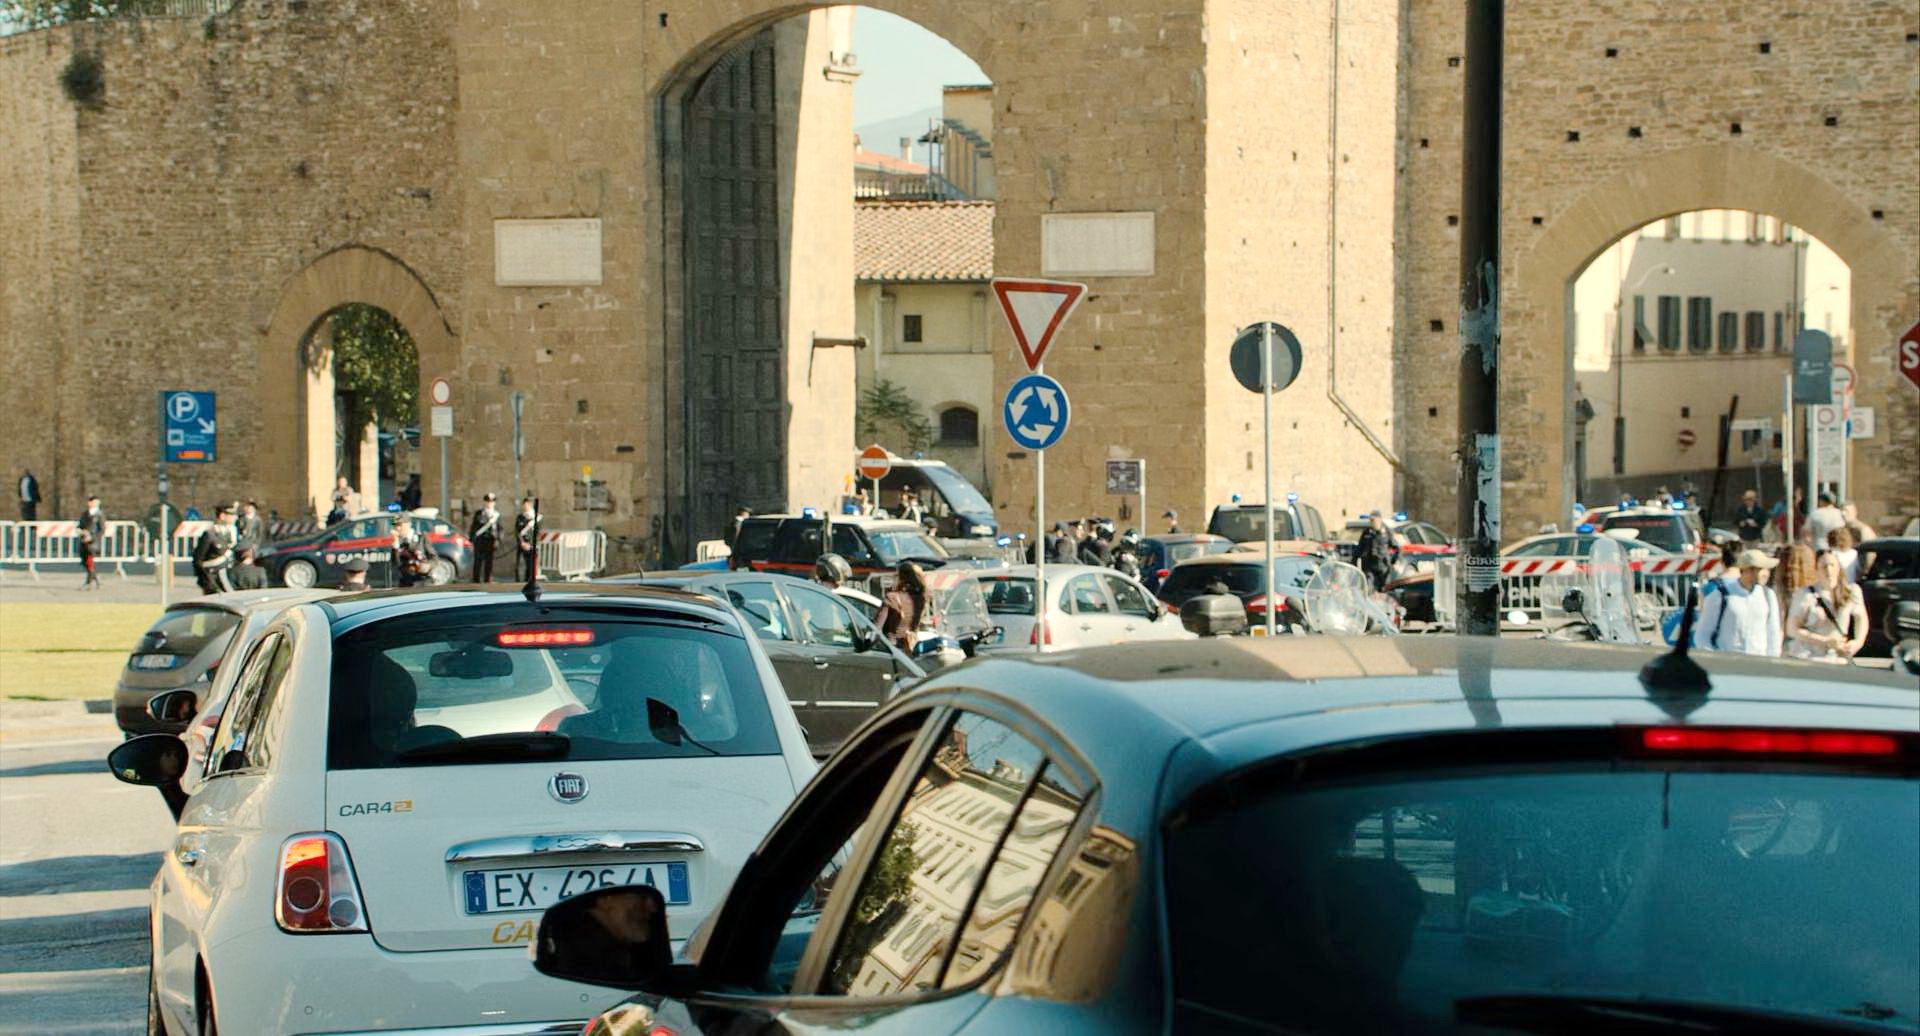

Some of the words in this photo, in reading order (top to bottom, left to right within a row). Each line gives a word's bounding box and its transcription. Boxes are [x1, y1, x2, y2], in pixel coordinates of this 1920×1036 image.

[175, 396, 195, 419] P
[559, 779, 581, 793] FIAT
[495, 873, 536, 907] EX
[491, 920, 534, 944] CA
